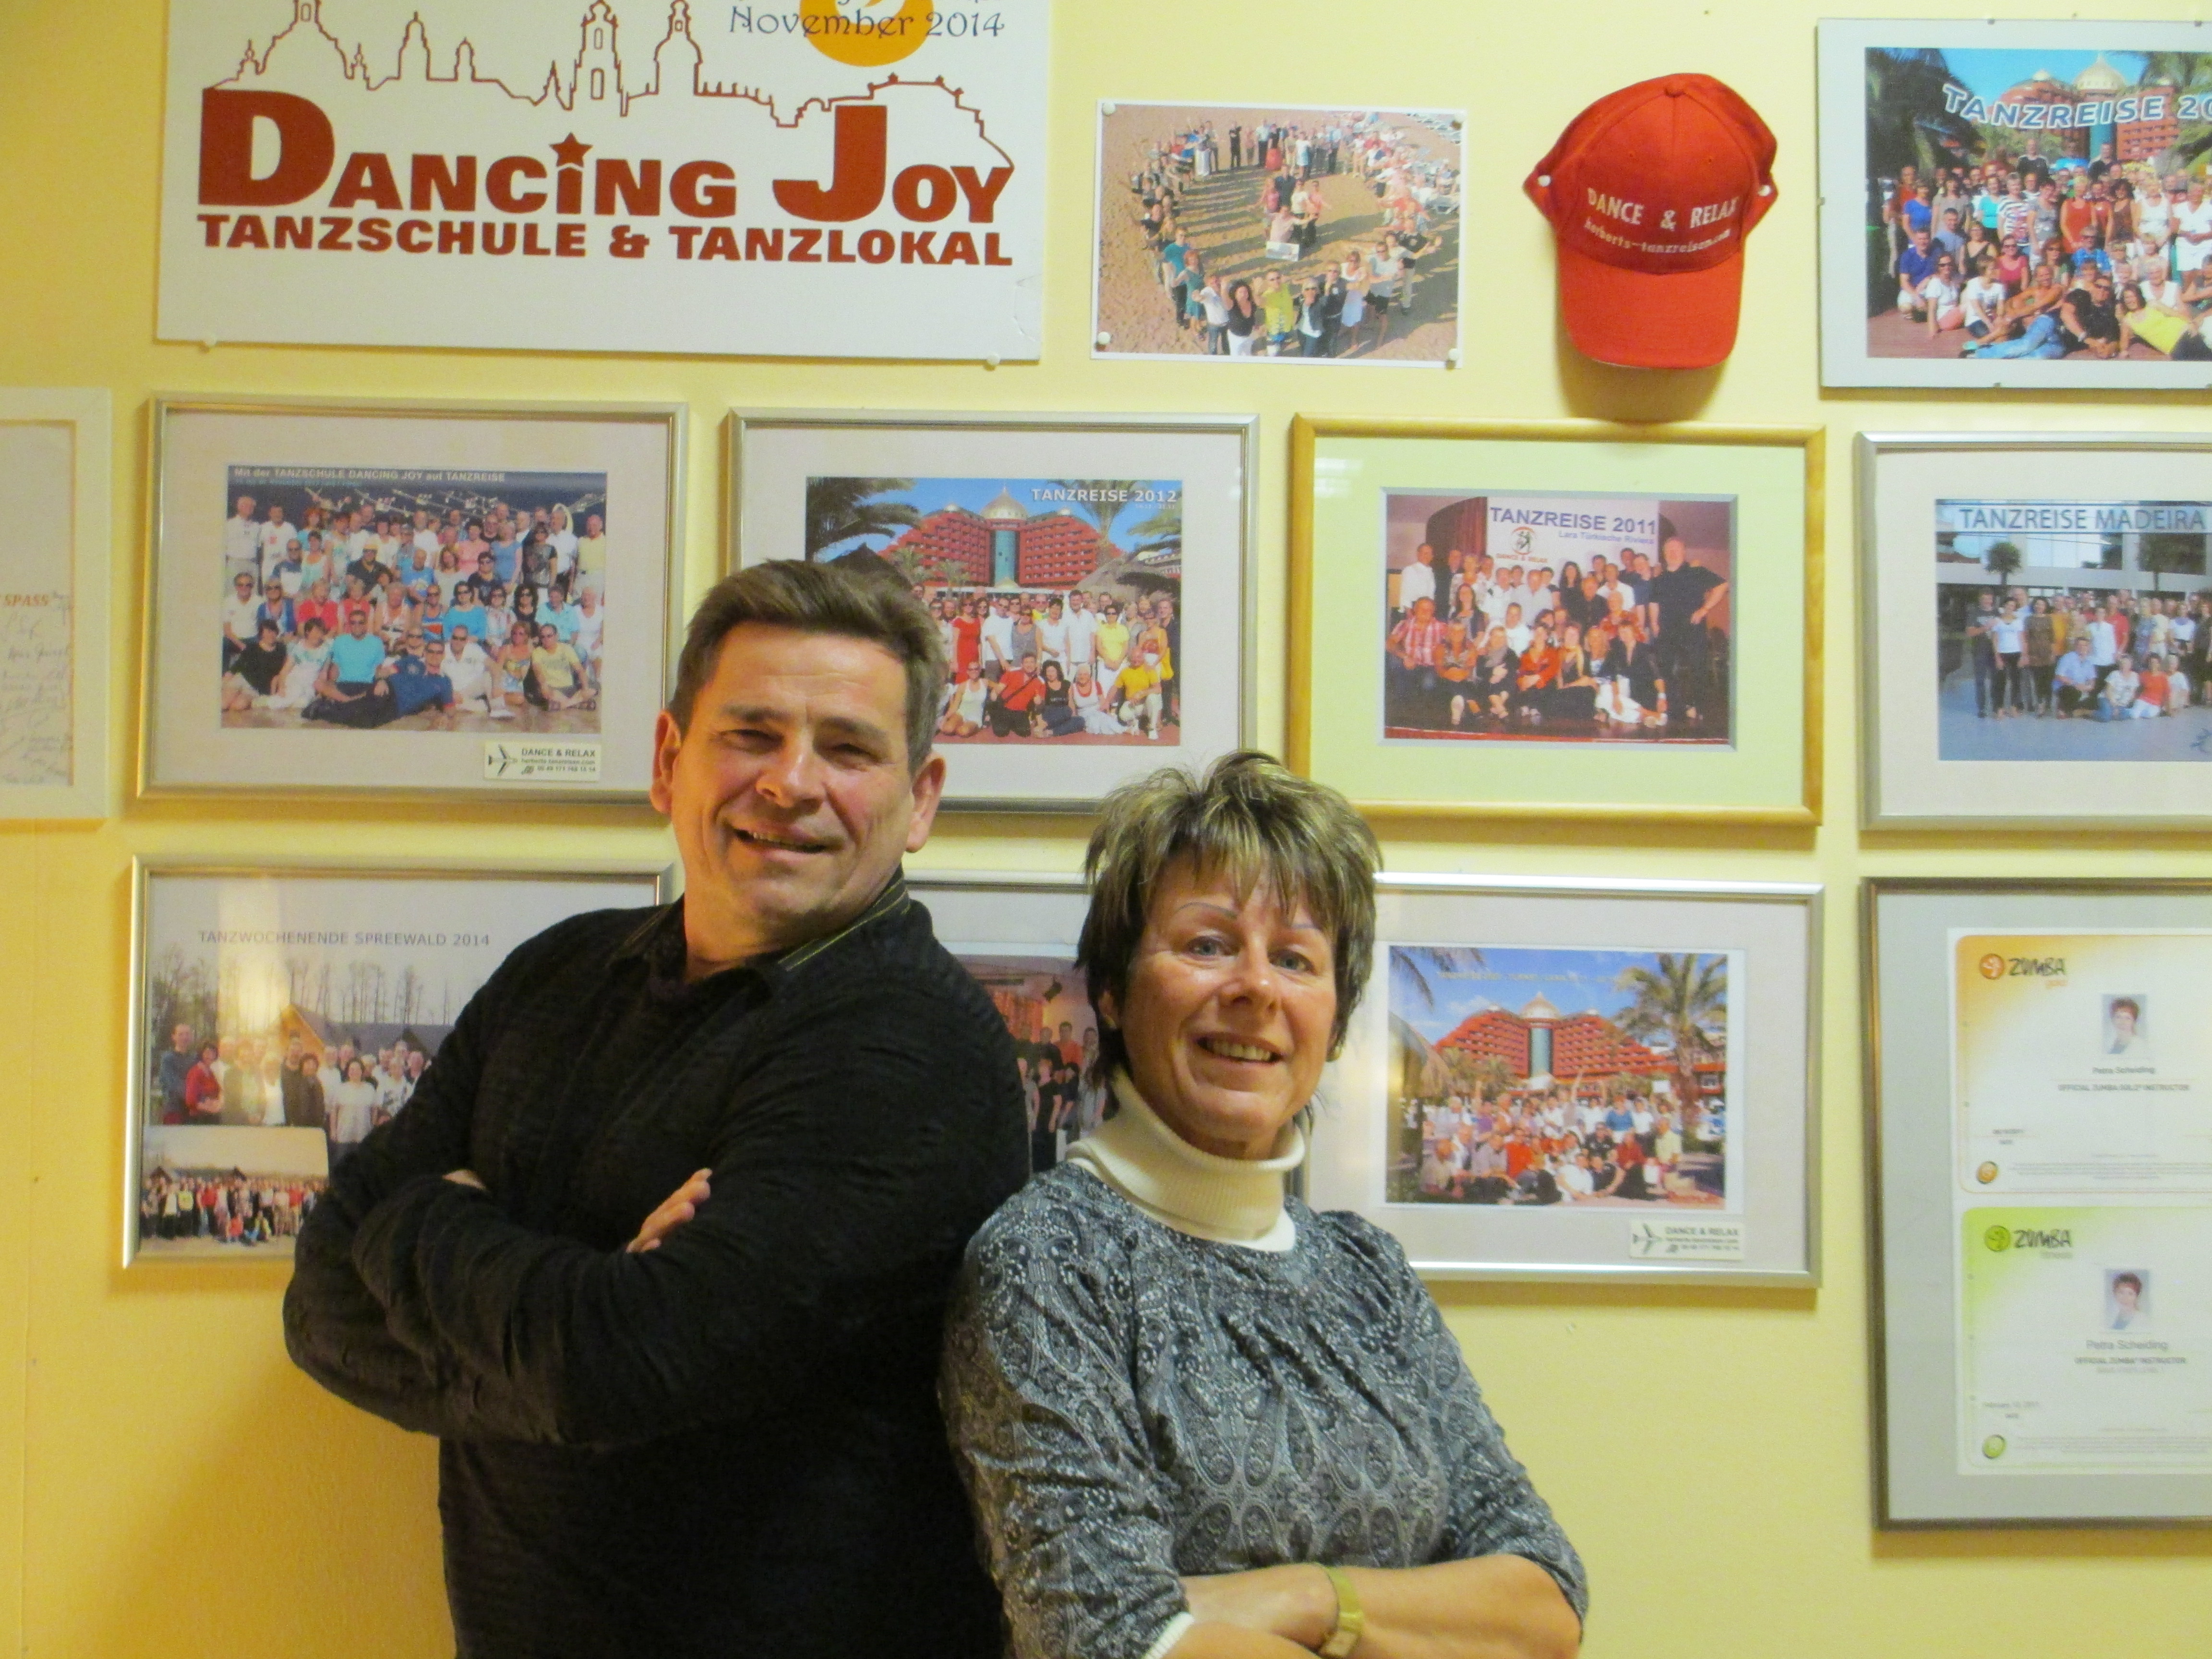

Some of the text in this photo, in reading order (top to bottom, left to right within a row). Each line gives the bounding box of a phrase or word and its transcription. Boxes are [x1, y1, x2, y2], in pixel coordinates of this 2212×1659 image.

[730, 6, 1005, 38] November 2014
[1942, 83, 2164, 130] TANZREISE
[772, 105, 1014, 223] JOY
[1587, 187, 1645, 226] DANCE
[1659, 209, 1677, 231] &
[197, 214, 1013, 266] TANZSCHULE & TANZLOKAL
[1030, 488, 1177, 503] TANZREISE 2012
[1490, 507, 1656, 535] TANZREISE 2011
[1960, 508, 2205, 530] TANZREISE MADEIRA
[521, 747, 553, 756] DANCE
[565, 748, 596, 757] RELAX
[198, 930, 490, 947] TANZWOCHENENDE SPREEWALD 2014
